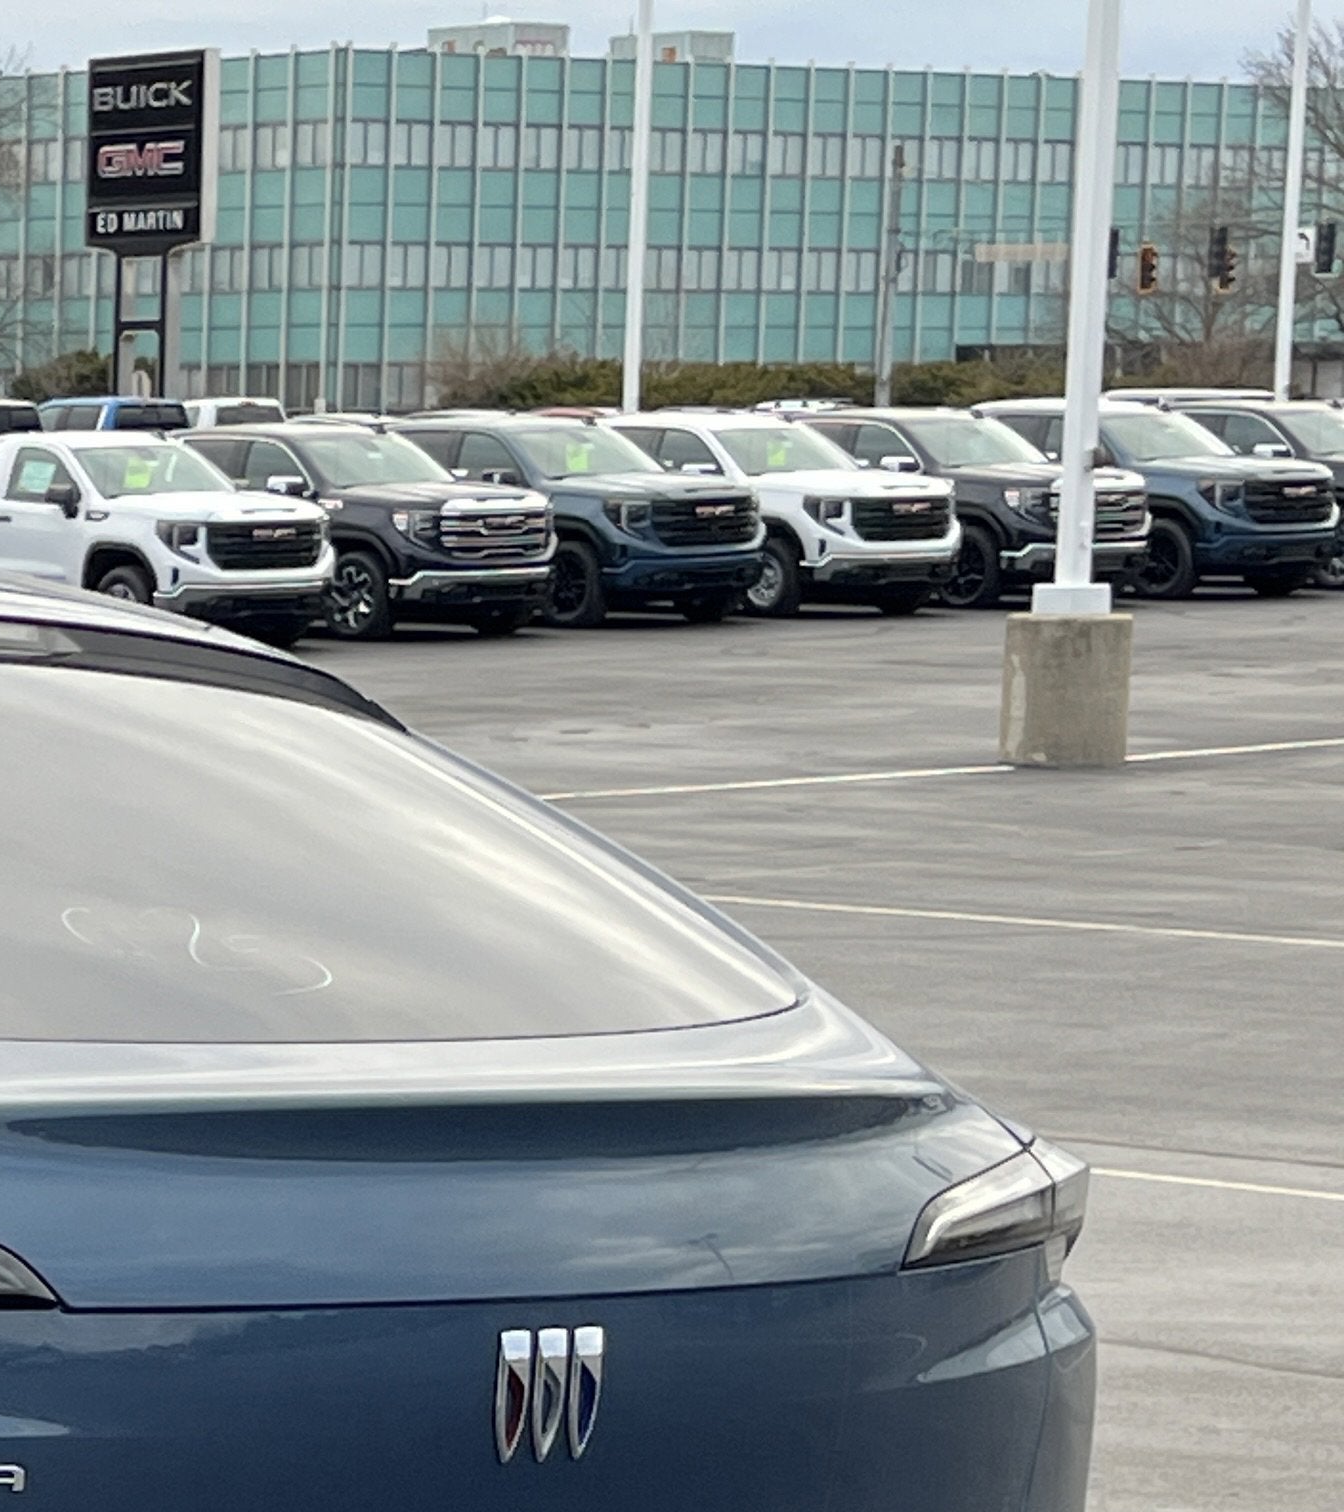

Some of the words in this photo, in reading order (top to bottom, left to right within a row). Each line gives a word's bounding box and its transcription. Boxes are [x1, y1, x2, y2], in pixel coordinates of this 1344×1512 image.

[92, 79, 193, 112] BUICK
[97, 140, 185, 178] GMC
[96, 212, 118, 234] ED
[122, 210, 184, 232] MARTIN
